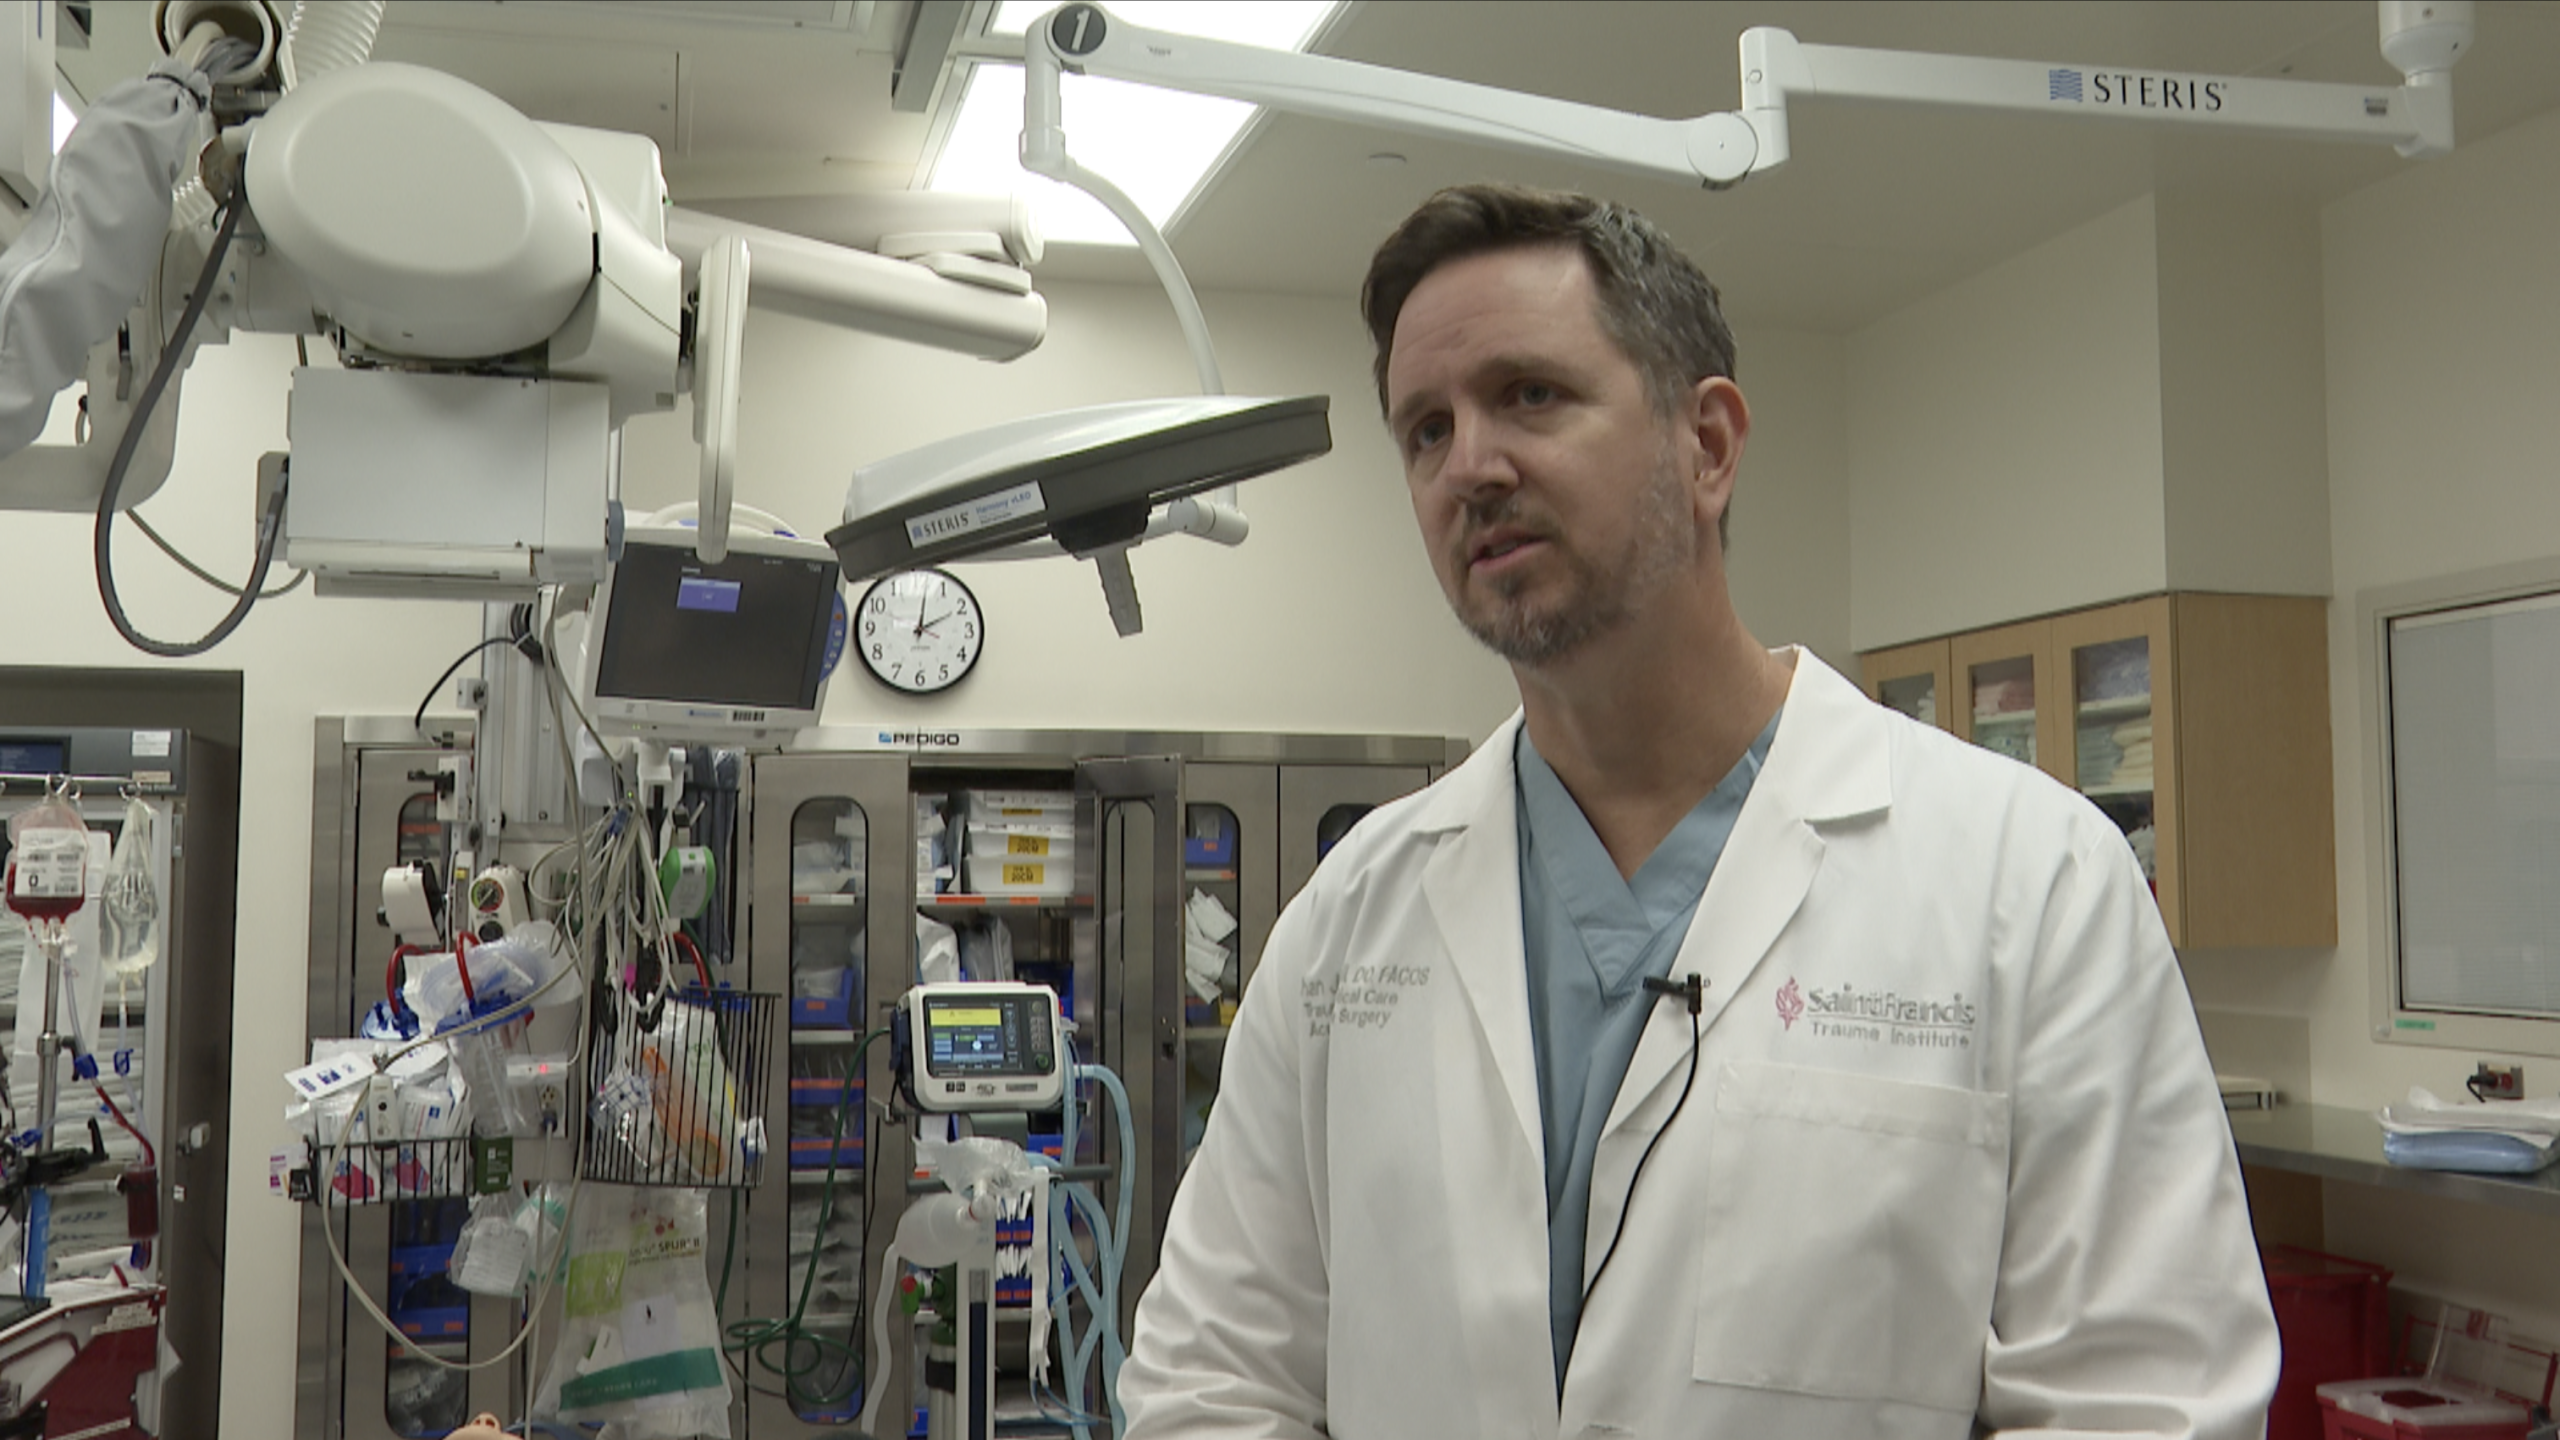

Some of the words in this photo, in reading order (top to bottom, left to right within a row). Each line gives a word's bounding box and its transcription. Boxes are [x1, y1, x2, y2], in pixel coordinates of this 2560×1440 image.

[1071, 8, 1091, 52] 1
[2093, 72, 2223, 112] STERIS
[923, 511, 970, 538] STERIS
[940, 580, 947, 598] 1
[870, 597, 886, 615] 10
[957, 597, 967, 615] 2
[865, 620, 876, 638] 9
[964, 621, 975, 640] 3
[871, 643, 883, 661] 8
[956, 645, 967, 662] 4
[891, 662, 902, 680] 7
[914, 669, 926, 687] 6
[938, 663, 949, 682] 5
[893, 732, 960, 746] PEDIGO
[1811, 1020, 1880, 1042] Trauma
[1890, 1026, 1970, 1048] Institute
